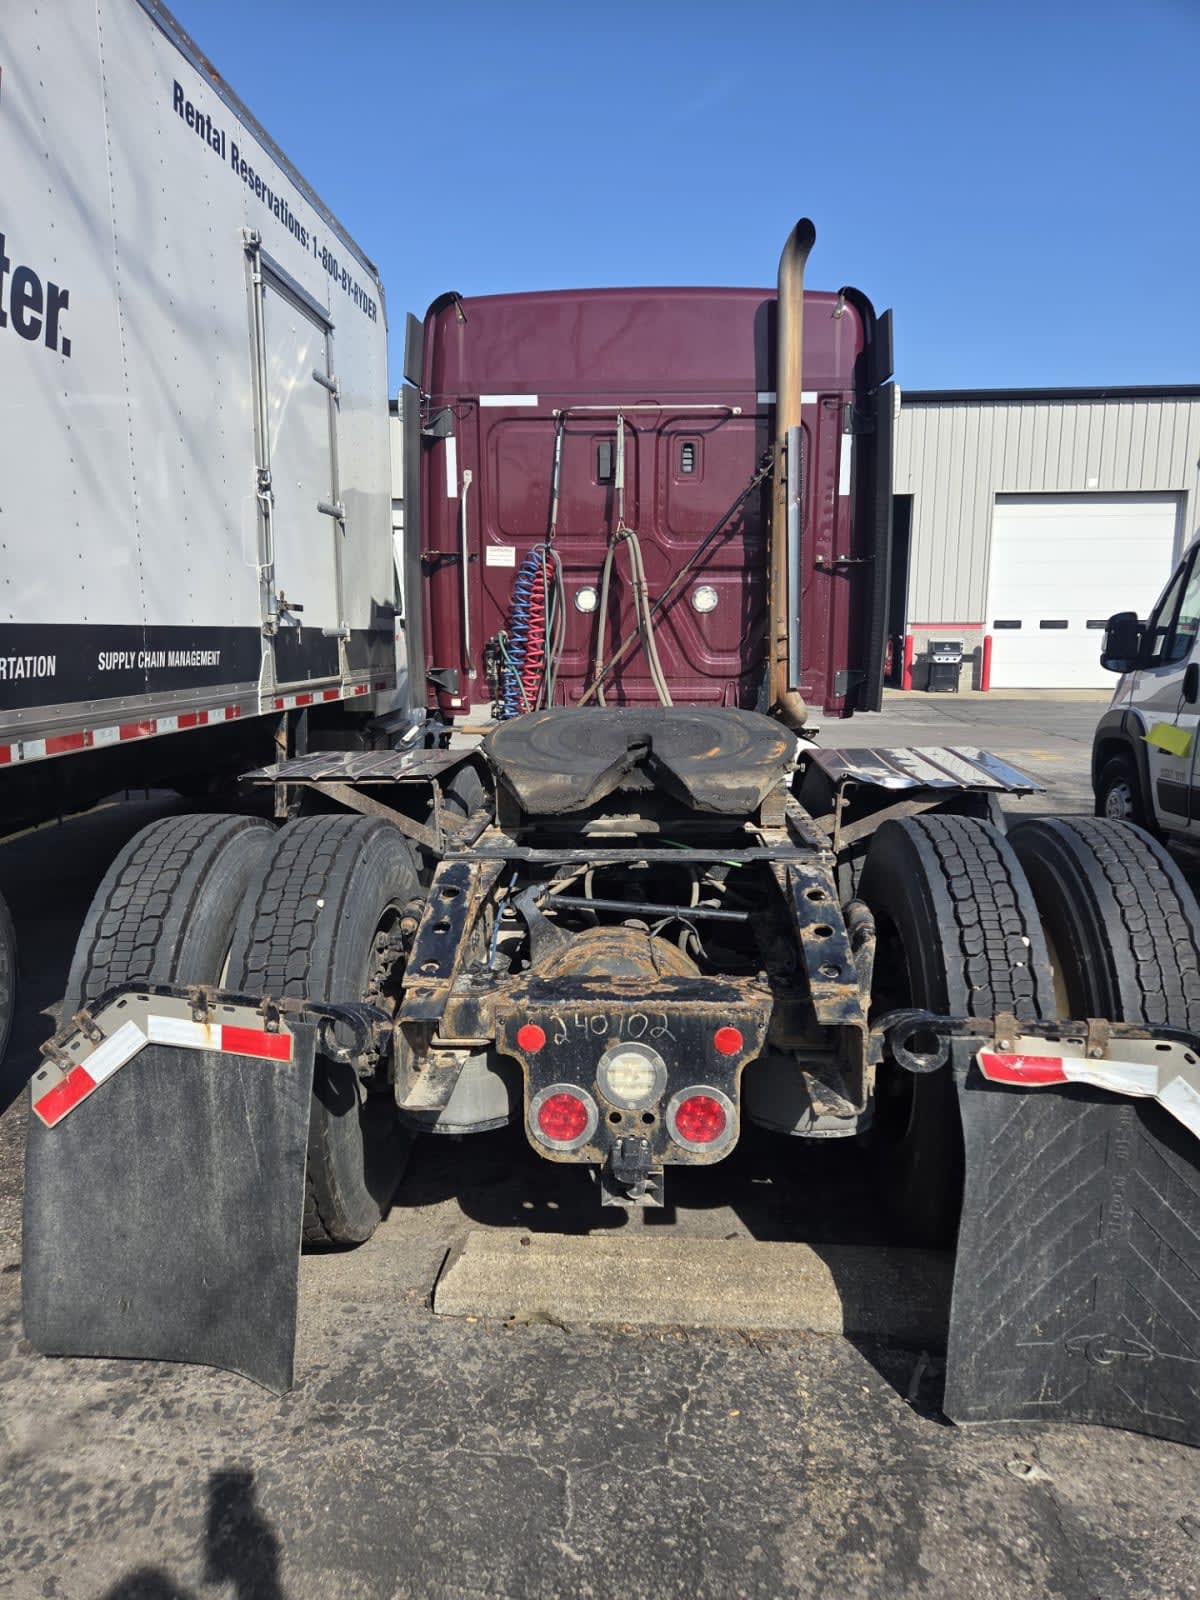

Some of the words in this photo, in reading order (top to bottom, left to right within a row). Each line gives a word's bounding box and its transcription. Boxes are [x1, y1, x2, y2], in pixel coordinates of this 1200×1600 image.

[173, 79, 226, 161] Rental
[230, 141, 310, 250] Reservations:
[313, 236, 377, 323] 1-800-BY-RYDER
[0, 655, 57, 680] RTATION
[98, 651, 136, 671] SUPPLY
[138, 650, 166, 669] CHAIN
[167, 650, 221, 668] MANAGEMENT
